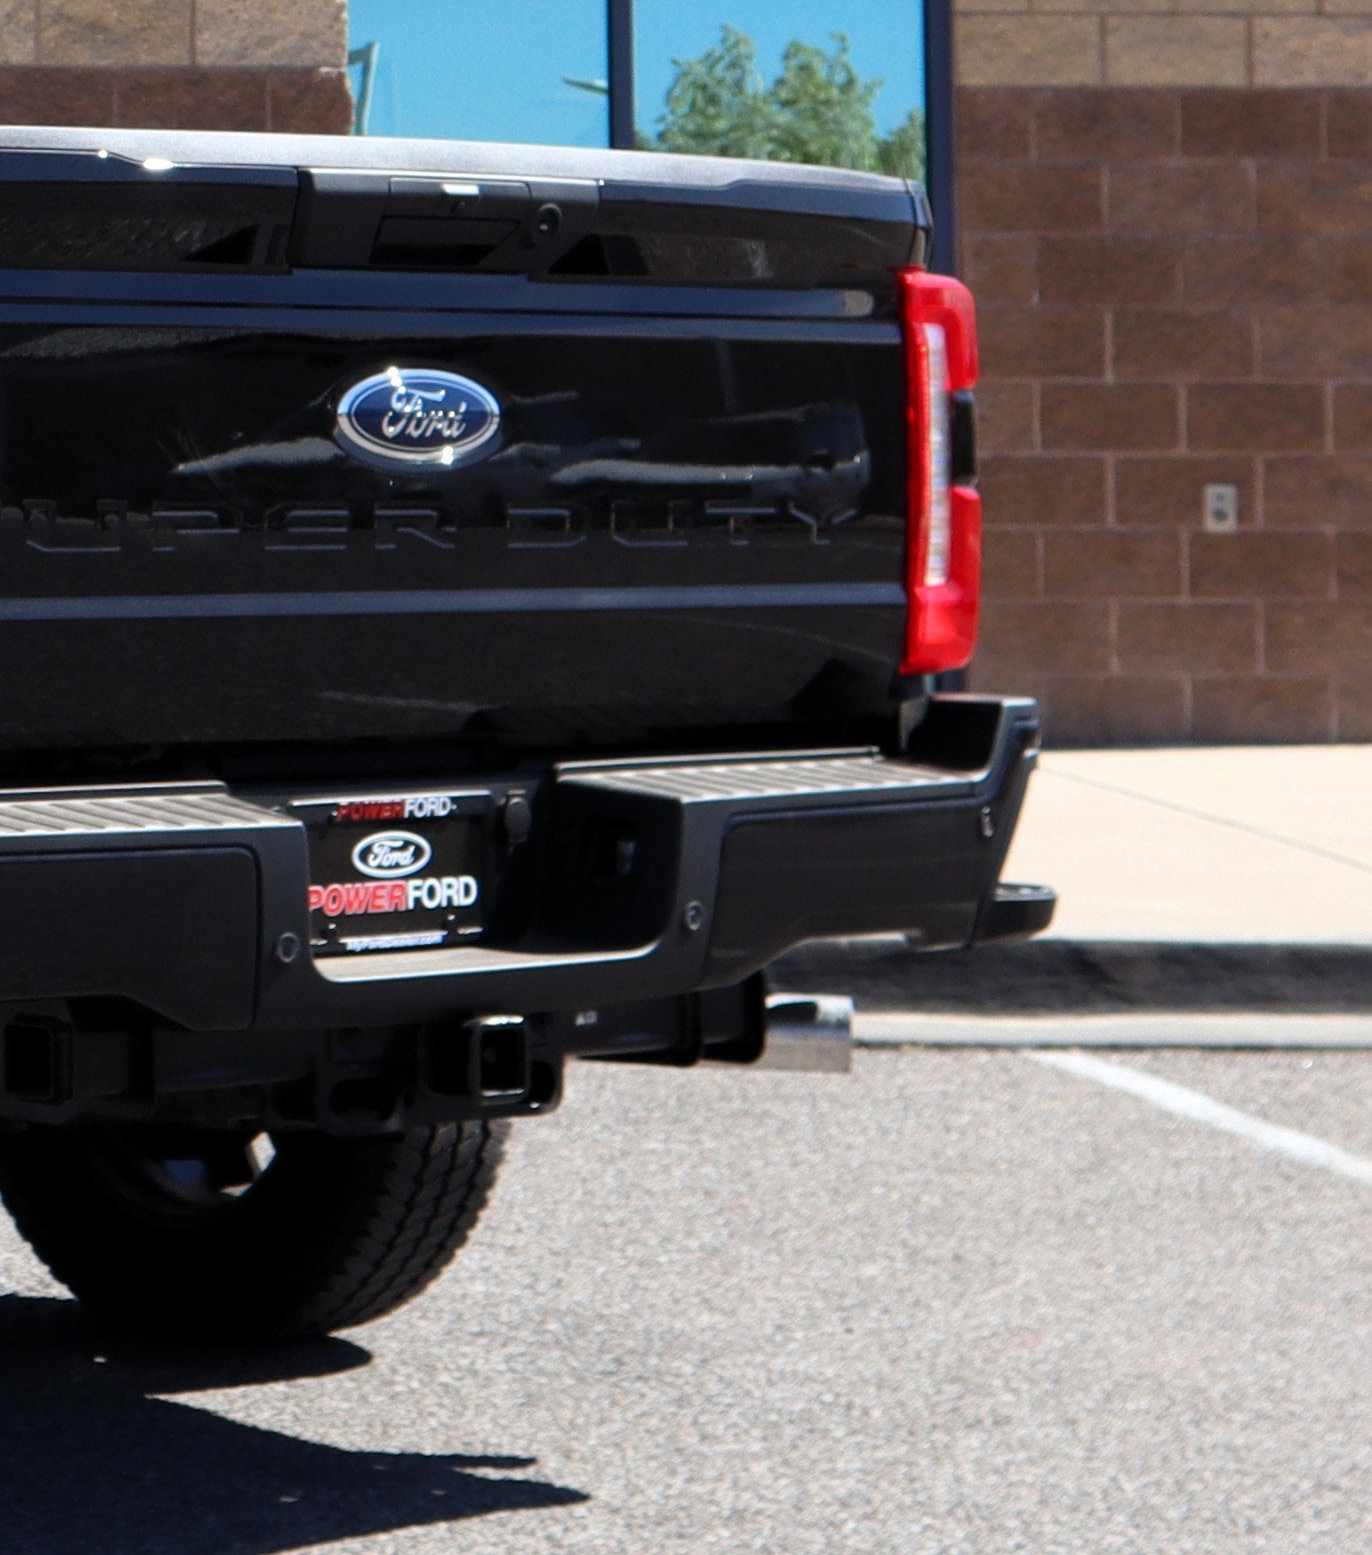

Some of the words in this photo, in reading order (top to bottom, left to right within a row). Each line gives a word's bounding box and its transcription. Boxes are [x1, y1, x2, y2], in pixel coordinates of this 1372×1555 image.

[381, 386, 467, 439] Ford
[505, 496, 860, 549] DUTY
[368, 841, 415, 868] Ford
